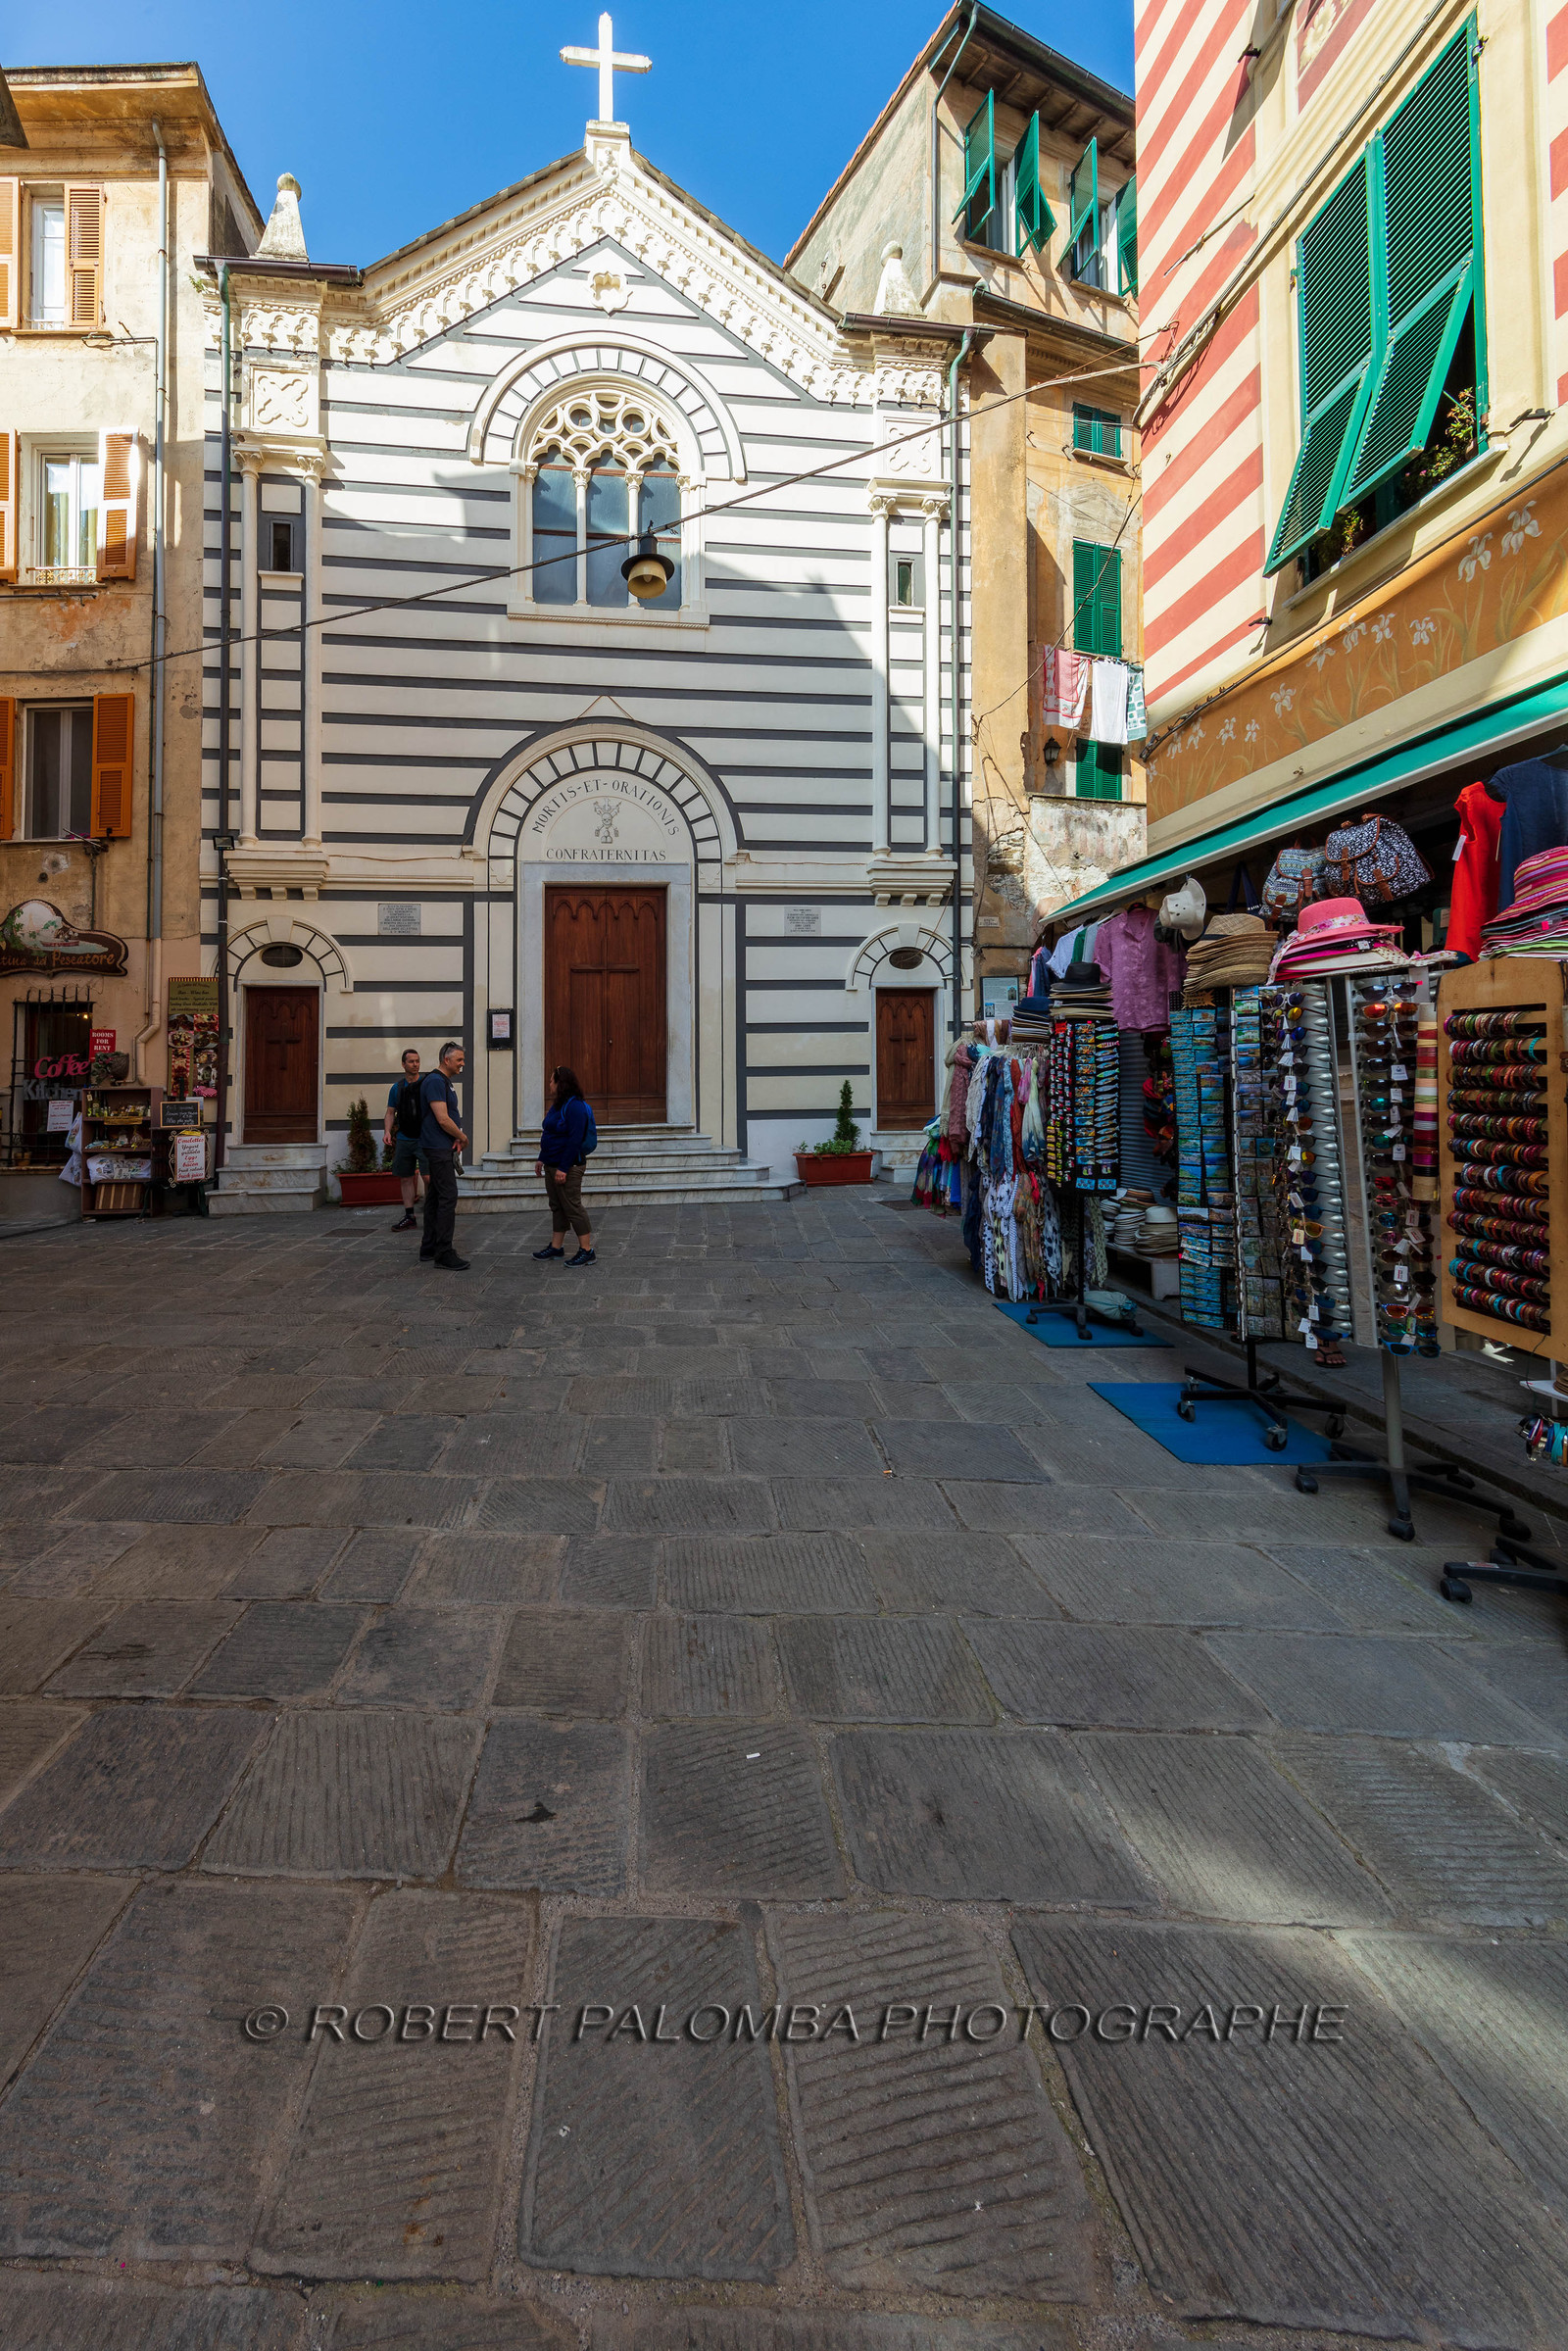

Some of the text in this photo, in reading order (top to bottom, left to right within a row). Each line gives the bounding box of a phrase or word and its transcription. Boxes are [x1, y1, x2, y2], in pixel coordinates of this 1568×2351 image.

[546, 849, 666, 861] CONFRATERNITAS
[52, 949, 116, 966] Pescatore
[33, 1053, 90, 1079] Coffee
[24, 1079, 83, 1101] Kitchen
